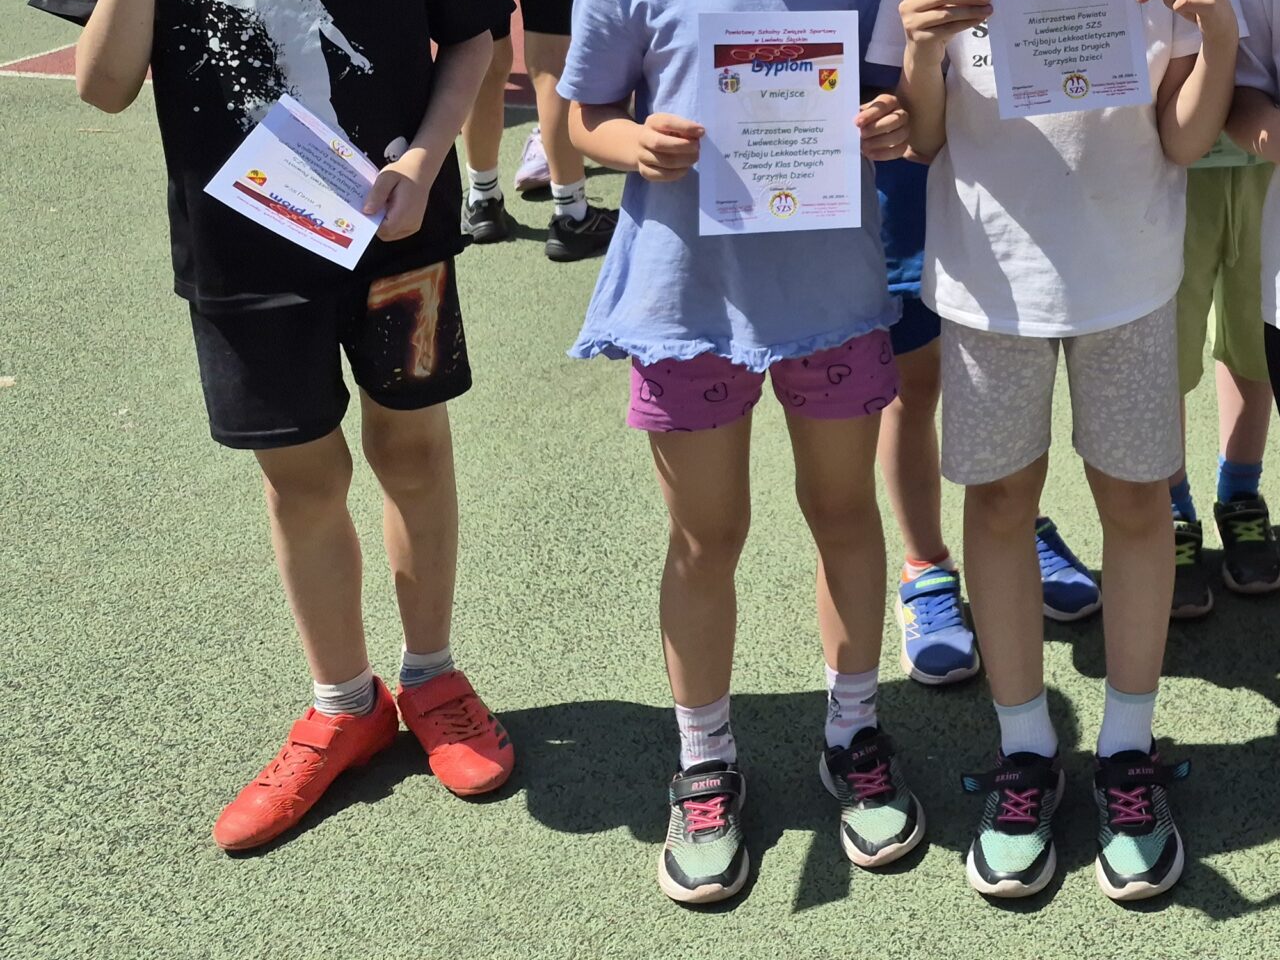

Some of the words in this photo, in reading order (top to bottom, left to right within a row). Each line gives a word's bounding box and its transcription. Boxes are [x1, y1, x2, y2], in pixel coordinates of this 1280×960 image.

[1028, 15, 1076, 25] Mistrzostwa
[1078, 11, 1106, 20] Powiatu
[1035, 24, 1083, 35] Lwóweckiego
[1085, 21, 1102, 29] SZS
[1024, 36, 1056, 47] Trójboju
[1058, 30, 1126, 42] Lekkoatletycznym
[1033, 46, 1062, 56] Zawody
[1064, 45, 1079, 53] Klas
[1081, 42, 1110, 52] Drugich
[1044, 57, 1077, 67] Igrzyska
[1080, 54, 1103, 62] Dzieci
[752, 59, 813, 77] Dyplom
[769, 90, 805, 100] miejsce
[1069, 86, 1084, 94] SZS
[794, 126, 824, 134] Powiatu
[748, 139, 798, 147] Lwóweckiego
[734, 150, 768, 159] Trójboju
[770, 148, 841, 158] Lekkoatletycznym
[742, 162, 773, 171] Zawody
[794, 160, 824, 169] Drugich
[752, 173, 787, 182] Igrzyska
[367, 260, 447, 377] 7
[853, 744, 878, 761] axim
[995, 772, 1020, 782] axim
[1127, 767, 1154, 776] axim
[691, 777, 721, 790] axim
